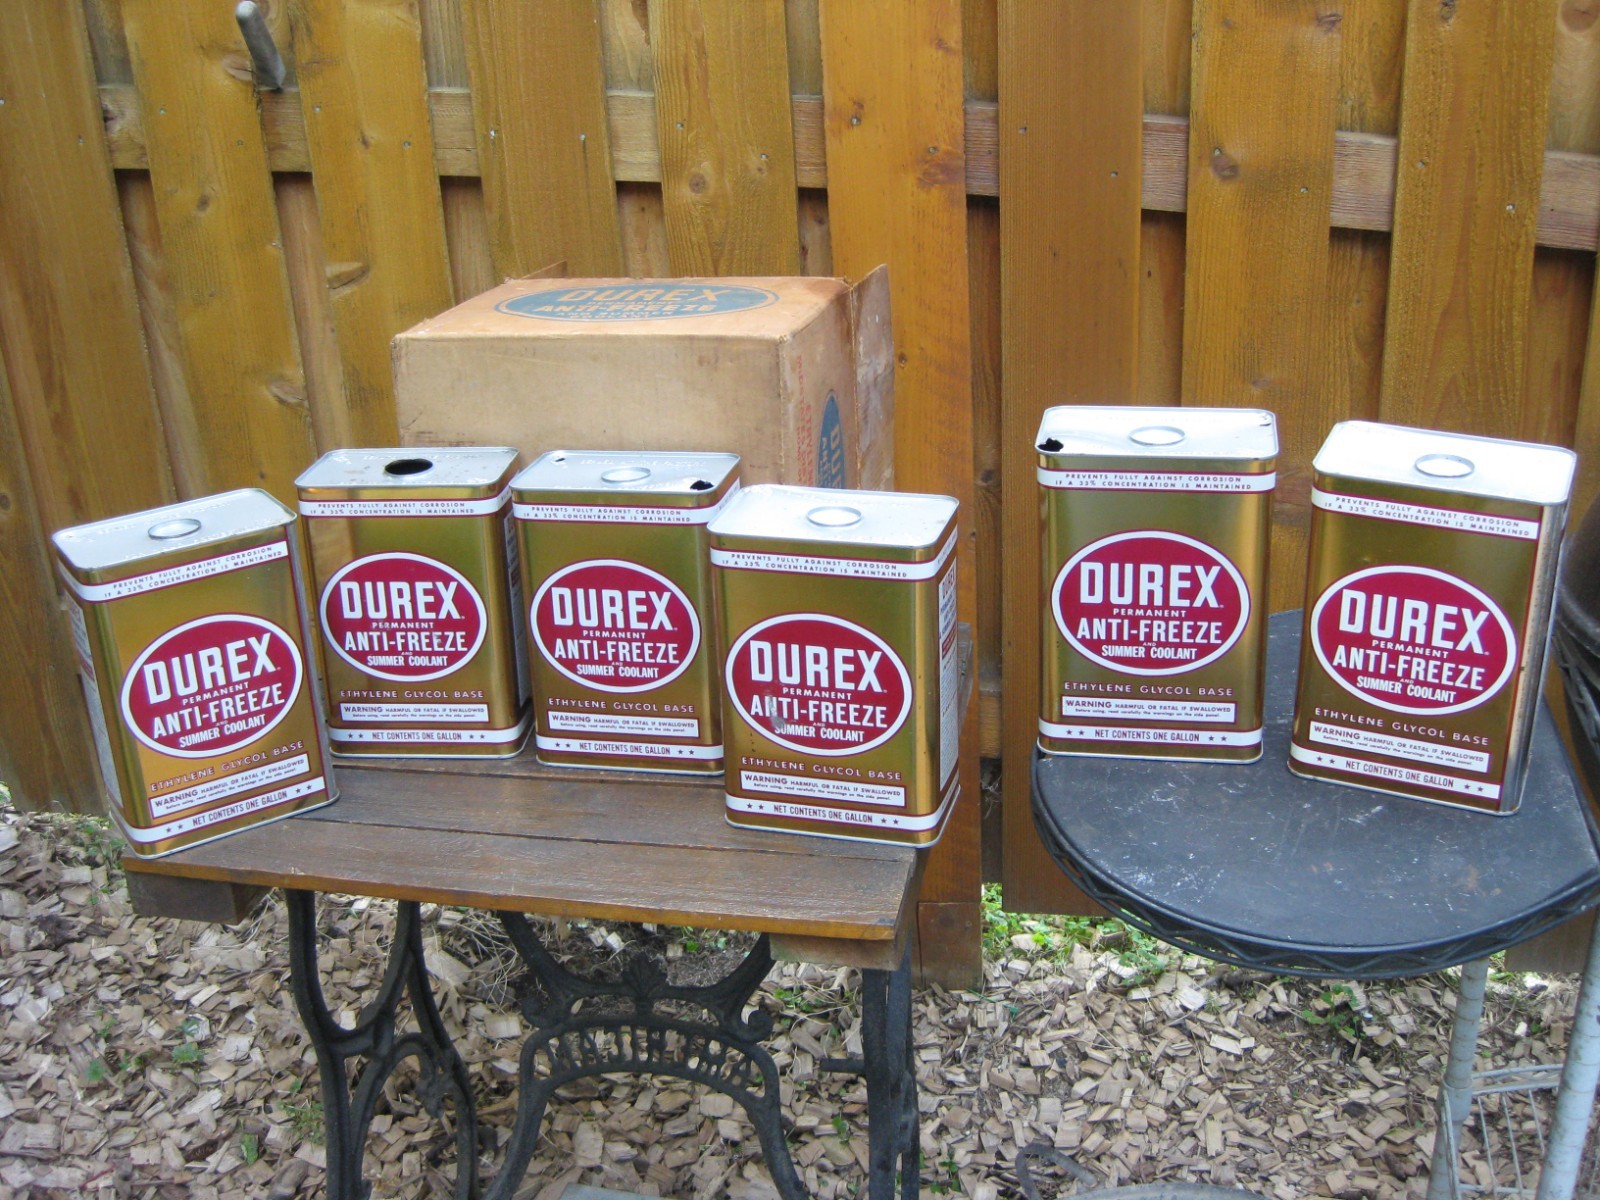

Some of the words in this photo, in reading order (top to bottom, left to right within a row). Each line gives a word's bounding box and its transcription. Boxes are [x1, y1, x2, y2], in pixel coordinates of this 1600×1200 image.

[557, 289, 732, 302] DUREX
[532, 304, 717, 312] ANTI-FREEZE
[1336, 496, 1379, 507] PREVENTS
[1385, 503, 1411, 512] FULLY
[1416, 508, 1457, 518] AGAINST
[731, 553, 771, 561] PREVENTS
[804, 558, 841, 566] AGAINST
[845, 561, 897, 570] CORROSION
[112, 575, 153, 589] PREVENTS
[158, 568, 181, 578] FULLY
[185, 558, 221, 571] AGAINST
[1079, 561, 1220, 608] DUREX
[338, 580, 462, 619] DUREX
[550, 586, 674, 630] DUREX
[1112, 607, 1186, 617] PERMANENT
[1338, 588, 1489, 654] DUREX
[371, 621, 435, 629] PERMANENT
[582, 629, 646, 639] PERMANENT
[1076, 617, 1222, 643] ANTI-FREEZE
[341, 630, 468, 651] ANTI-FREEZE
[552, 638, 679, 663] ANTI-FREEZE
[1371, 638, 1448, 659] PERMANENT
[366, 655, 404, 666] SUMMER
[407, 655, 449, 666] COOLANT
[1101, 645, 1145, 657] SUMMER
[1149, 647, 1197, 659] COOLANT
[142, 631, 277, 706] DUREX
[576, 664, 614, 676] SUMMER
[618, 666, 659, 678] COOLANT
[748, 639, 884, 692] DUREX
[1331, 643, 1485, 690] ANTI-FREEZE
[181, 680, 249, 706] PERMANENT
[339, 689, 398, 698] ETHYLENE
[403, 690, 449, 698] GLYCOL
[453, 690, 483, 698] BASE
[782, 686, 852, 700] PERMANENT
[1064, 682, 1131, 692] ETHYLENE
[1139, 685, 1191, 695] GLYCOL
[1198, 686, 1232, 696] BASE
[1355, 675, 1402, 694] SUMMER
[1406, 684, 1456, 703] COOLANT
[149, 681, 285, 739] ANTI-FREEZE
[548, 698, 606, 708] ETHYLENE
[612, 701, 658, 711] GLYCOL
[663, 703, 694, 713] BASE
[748, 694, 887, 727] ANTI-FREEZE
[1065, 699, 1112, 708] WARNING
[551, 714, 591, 723] WARNING
[1314, 707, 1384, 727] ETHYLENE
[1391, 721, 1446, 738] GLYCOL
[1452, 731, 1489, 746] BASE
[178, 726, 220, 748] SUMMER
[222, 713, 267, 736] COOLANT
[371, 731, 385, 740] NET
[385, 731, 420, 740] CONTENTS
[421, 731, 435, 740] ONE
[435, 731, 462, 740] GALLON
[773, 722, 815, 737] SUMMER
[819, 727, 865, 742] COOLANT
[1094, 728, 1109, 738] NET
[1111, 729, 1150, 740] CONTENTS
[1152, 731, 1168, 741] ONE
[1170, 732, 1199, 741] GALLON
[578, 741, 592, 751] NET
[593, 742, 628, 752] CONTENTS
[629, 744, 643, 753] ONE
[644, 745, 670, 755] GALLON
[1313, 725, 1360, 740] WARNING
[1363, 736, 1394, 746] HARMFUL
[1408, 743, 1429, 752] FATAL
[1440, 749, 1484, 762] SWALLOWED
[150, 766, 214, 792] ETHYLENE
[220, 750, 268, 772] GLYCOL
[272, 740, 303, 756] BASE
[741, 756, 805, 771] ETHYLENE
[812, 764, 862, 777] GLYCOL
[868, 769, 901, 780] BASE
[1344, 759, 1361, 771] NET
[1362, 762, 1403, 779] CONTENTS
[1404, 770, 1421, 782] ONE
[1422, 773, 1454, 788] GALLON
[154, 788, 198, 808] WARNING
[200, 781, 228, 794] HARMFUL
[229, 777, 239, 785] OR
[240, 772, 258, 782] FATAL
[267, 758, 304, 774] SWALLOWED
[744, 774, 787, 785] WARNING
[790, 780, 818, 788] HARMFUL
[860, 787, 900, 796] SWALLOWED
[191, 814, 207, 827] NET
[207, 802, 244, 822] CONTENTS
[245, 798, 259, 810] ONE
[260, 789, 287, 805] GALLON
[773, 804, 787, 814] NET
[789, 805, 826, 818] CONTENTS
[828, 810, 842, 820] ONE
[844, 811, 873, 823] GALLON
